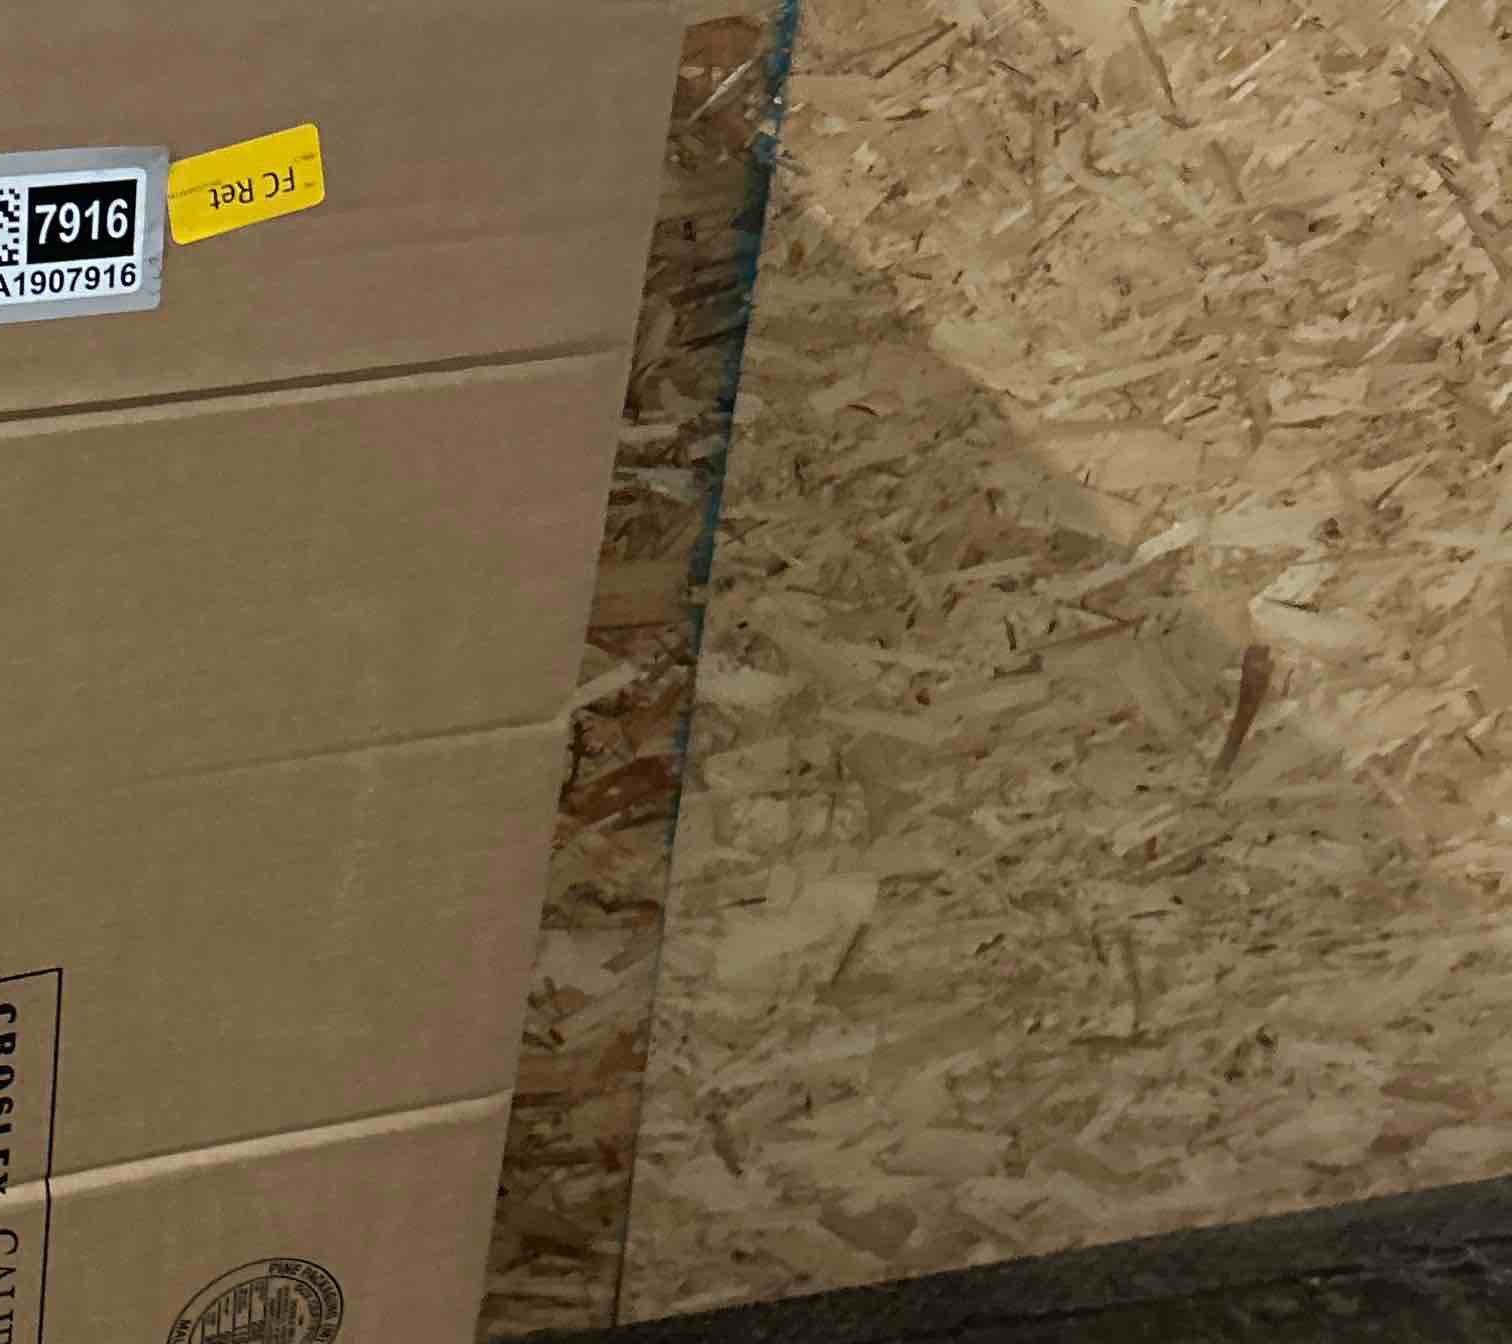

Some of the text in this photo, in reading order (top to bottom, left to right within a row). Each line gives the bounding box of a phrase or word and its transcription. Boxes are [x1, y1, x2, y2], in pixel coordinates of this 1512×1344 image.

[208, 178, 254, 210] Ret
[262, 166, 295, 198] FC
[34, 197, 128, 245] 7916
